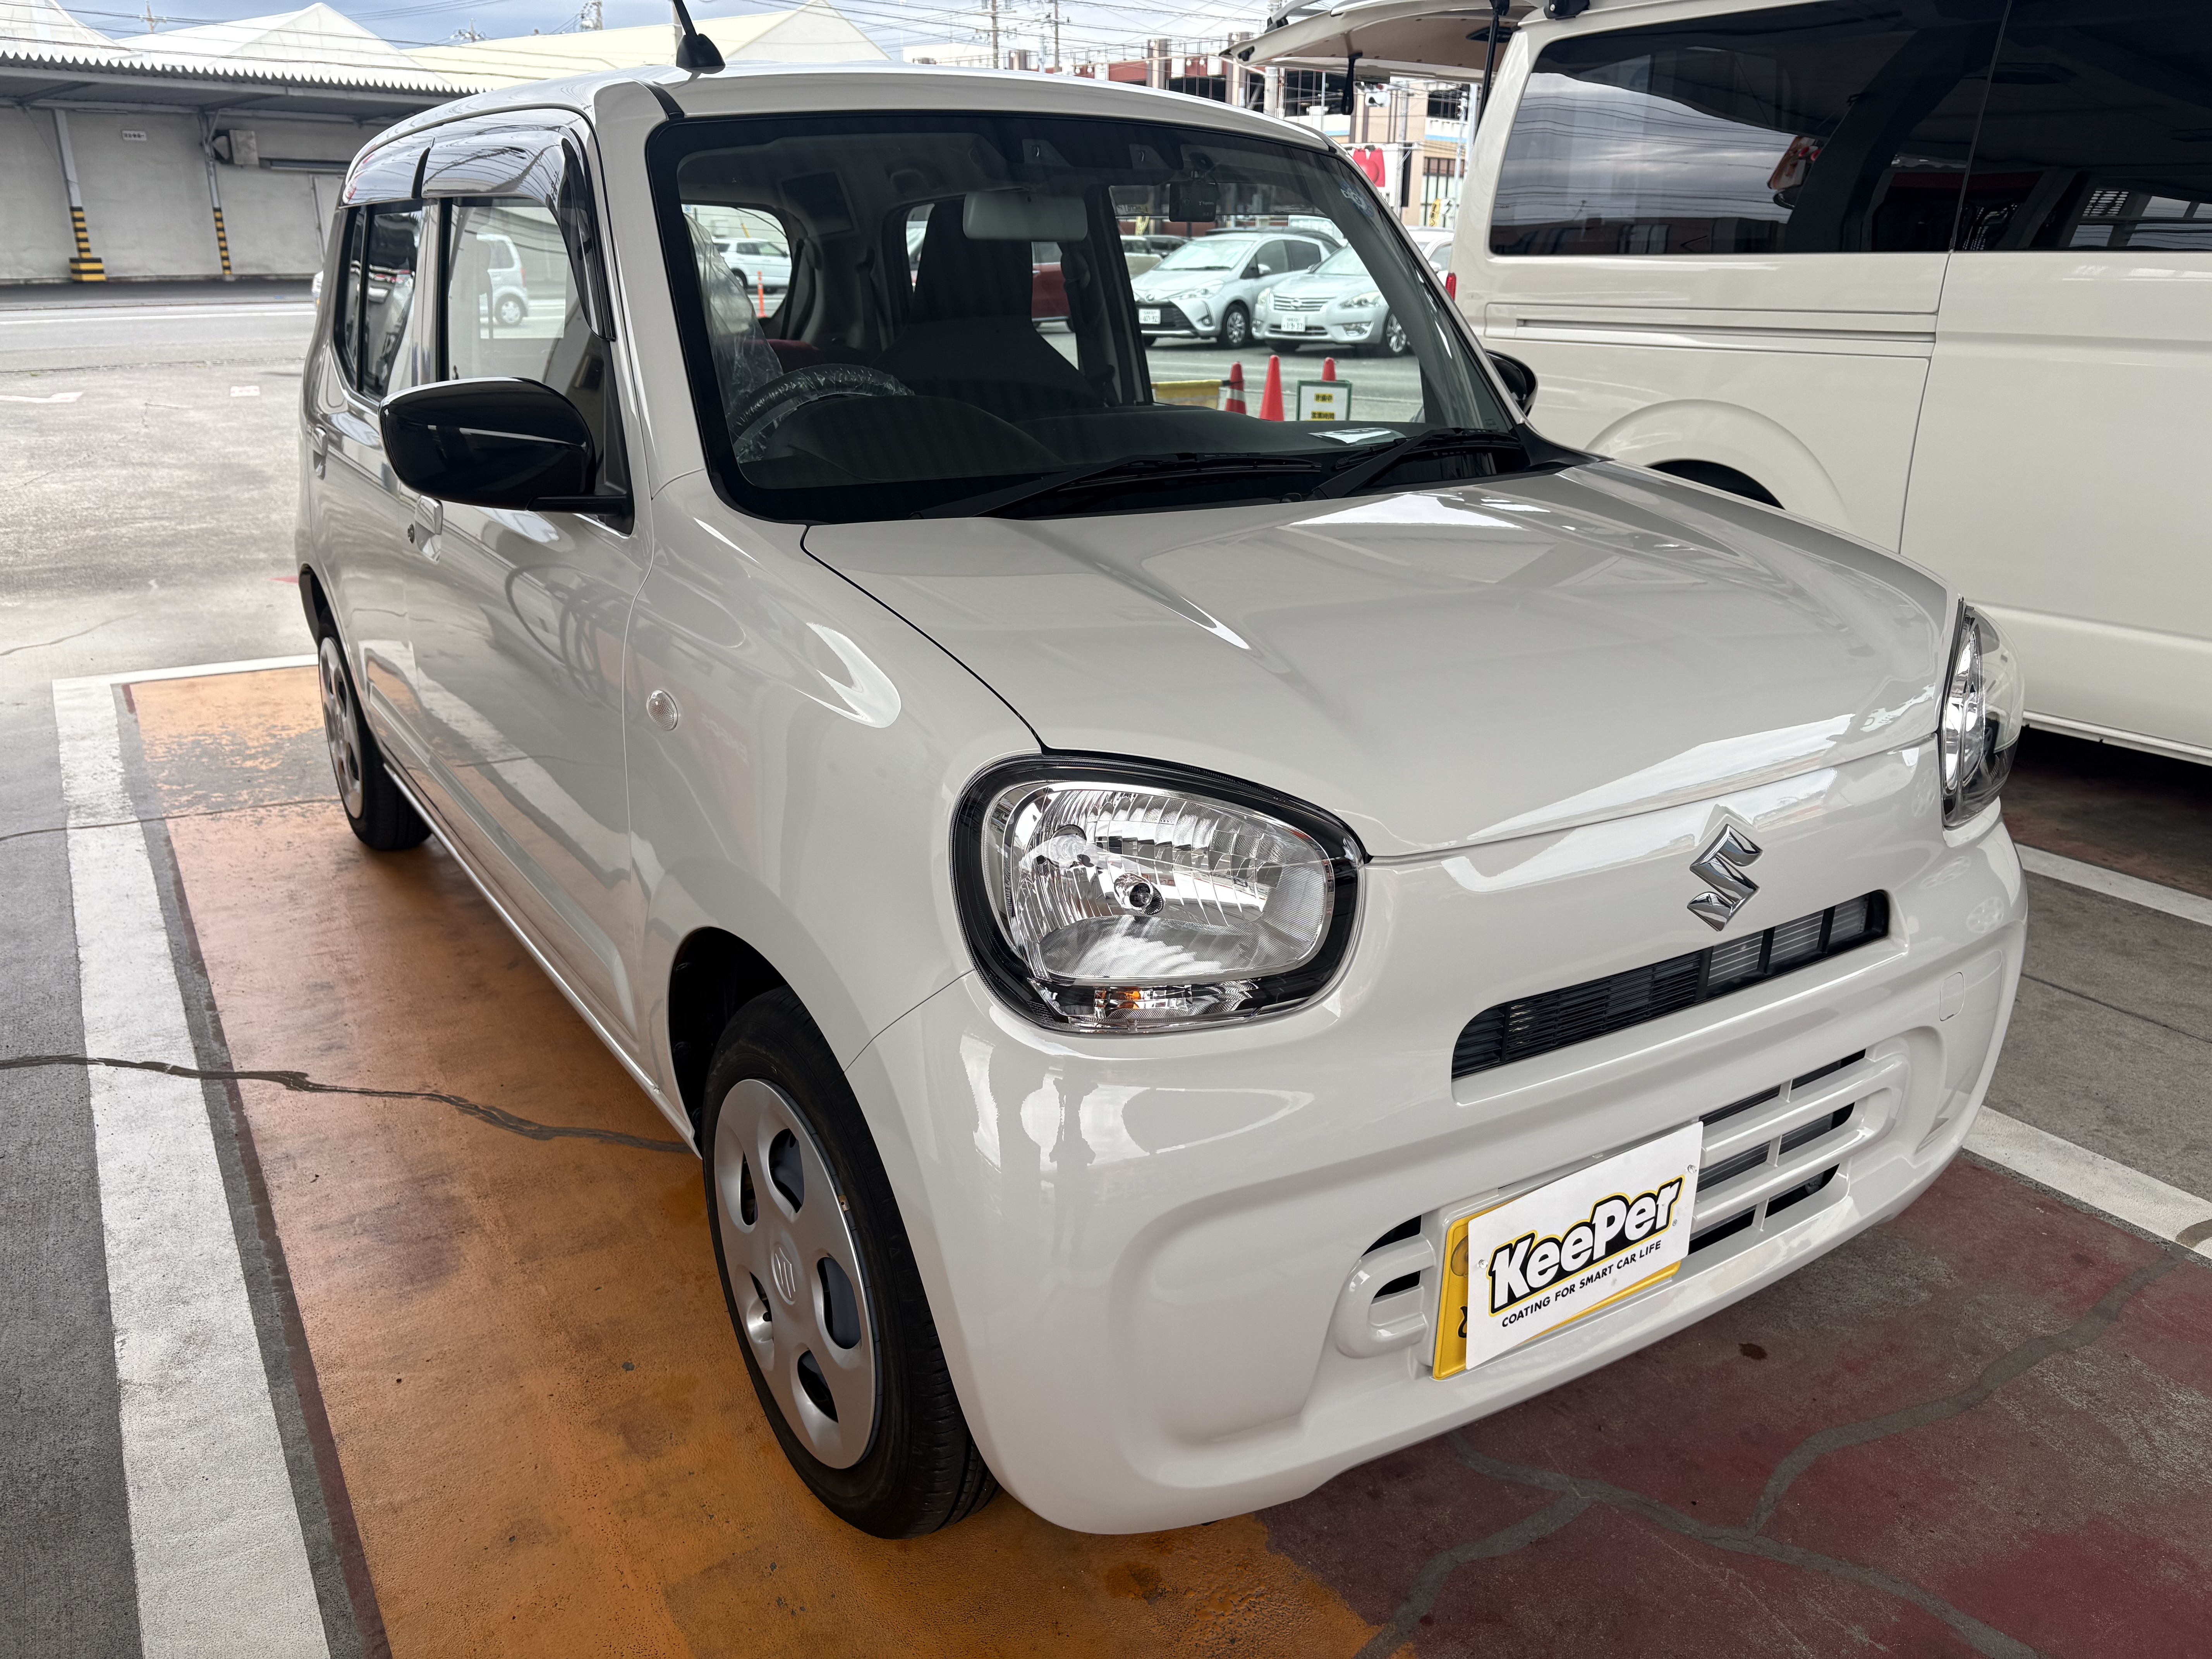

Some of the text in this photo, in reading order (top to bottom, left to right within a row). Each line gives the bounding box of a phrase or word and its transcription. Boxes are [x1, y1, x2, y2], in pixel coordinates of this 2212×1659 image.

[1489, 1177, 1683, 1314] KeePer
[1502, 1240, 1662, 1327] COATING FOR SMART CAR LIFE
